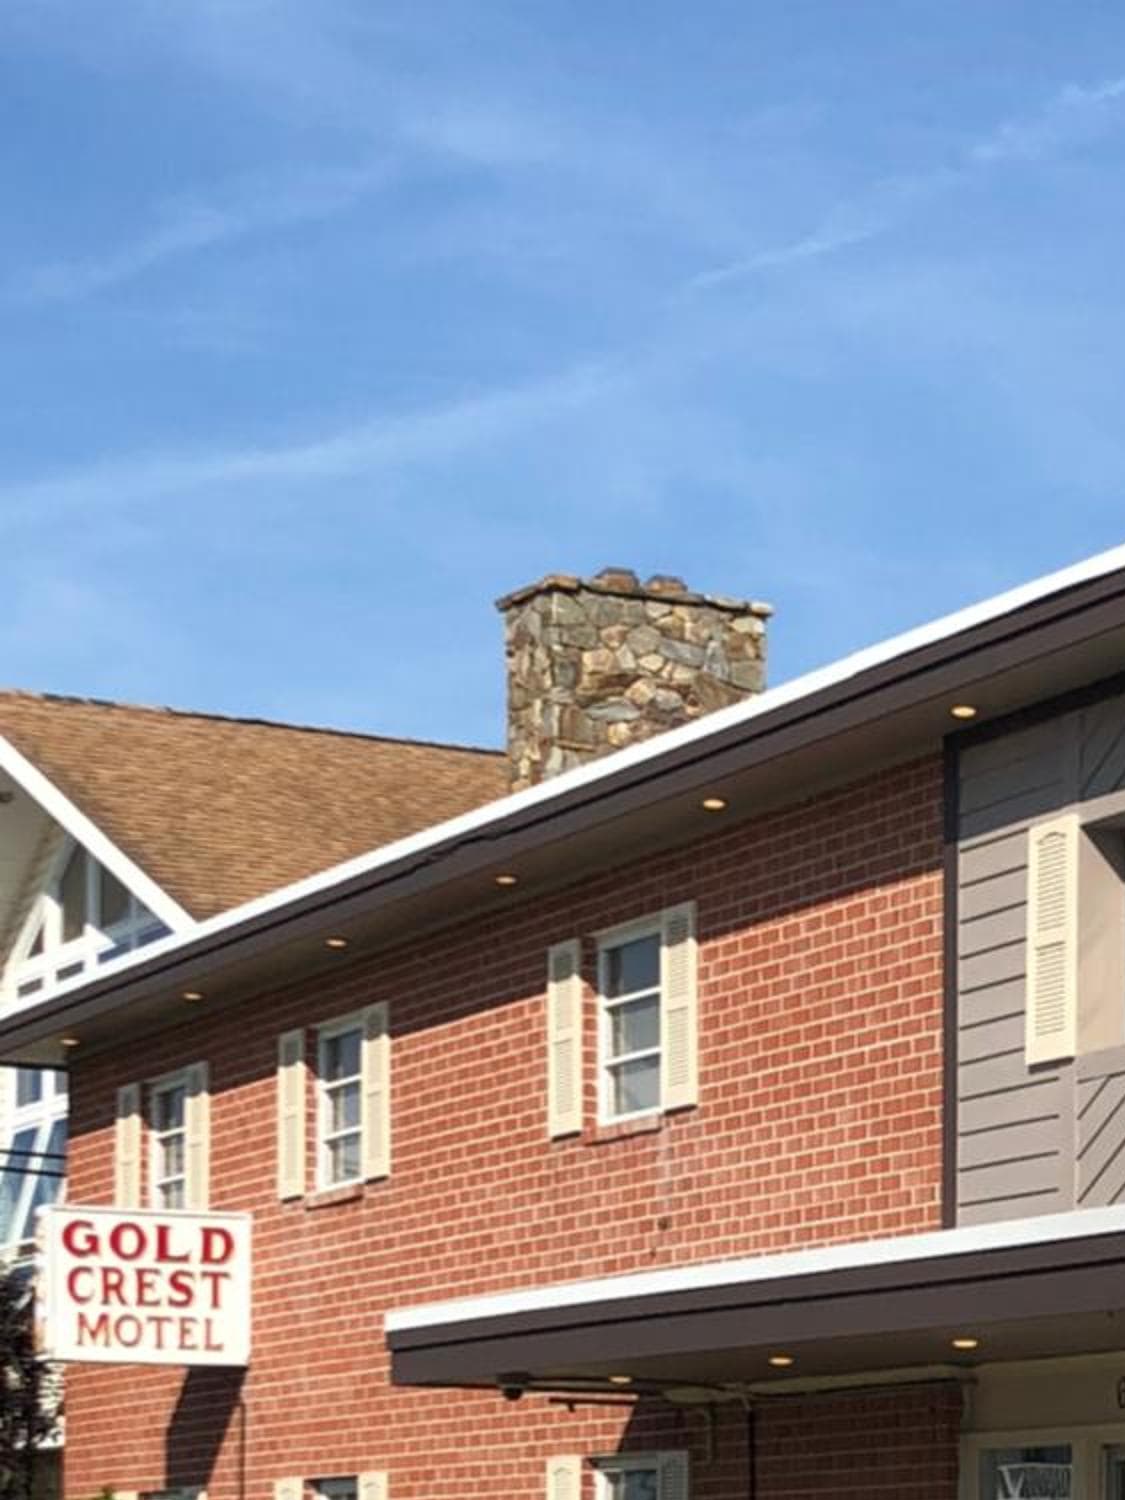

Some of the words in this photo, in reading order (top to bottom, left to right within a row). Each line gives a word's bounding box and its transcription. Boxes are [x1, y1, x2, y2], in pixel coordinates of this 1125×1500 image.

[61, 1219, 236, 1265] GOLD
[66, 1265, 231, 1309] CREST
[76, 1312, 224, 1351] MOTEL
